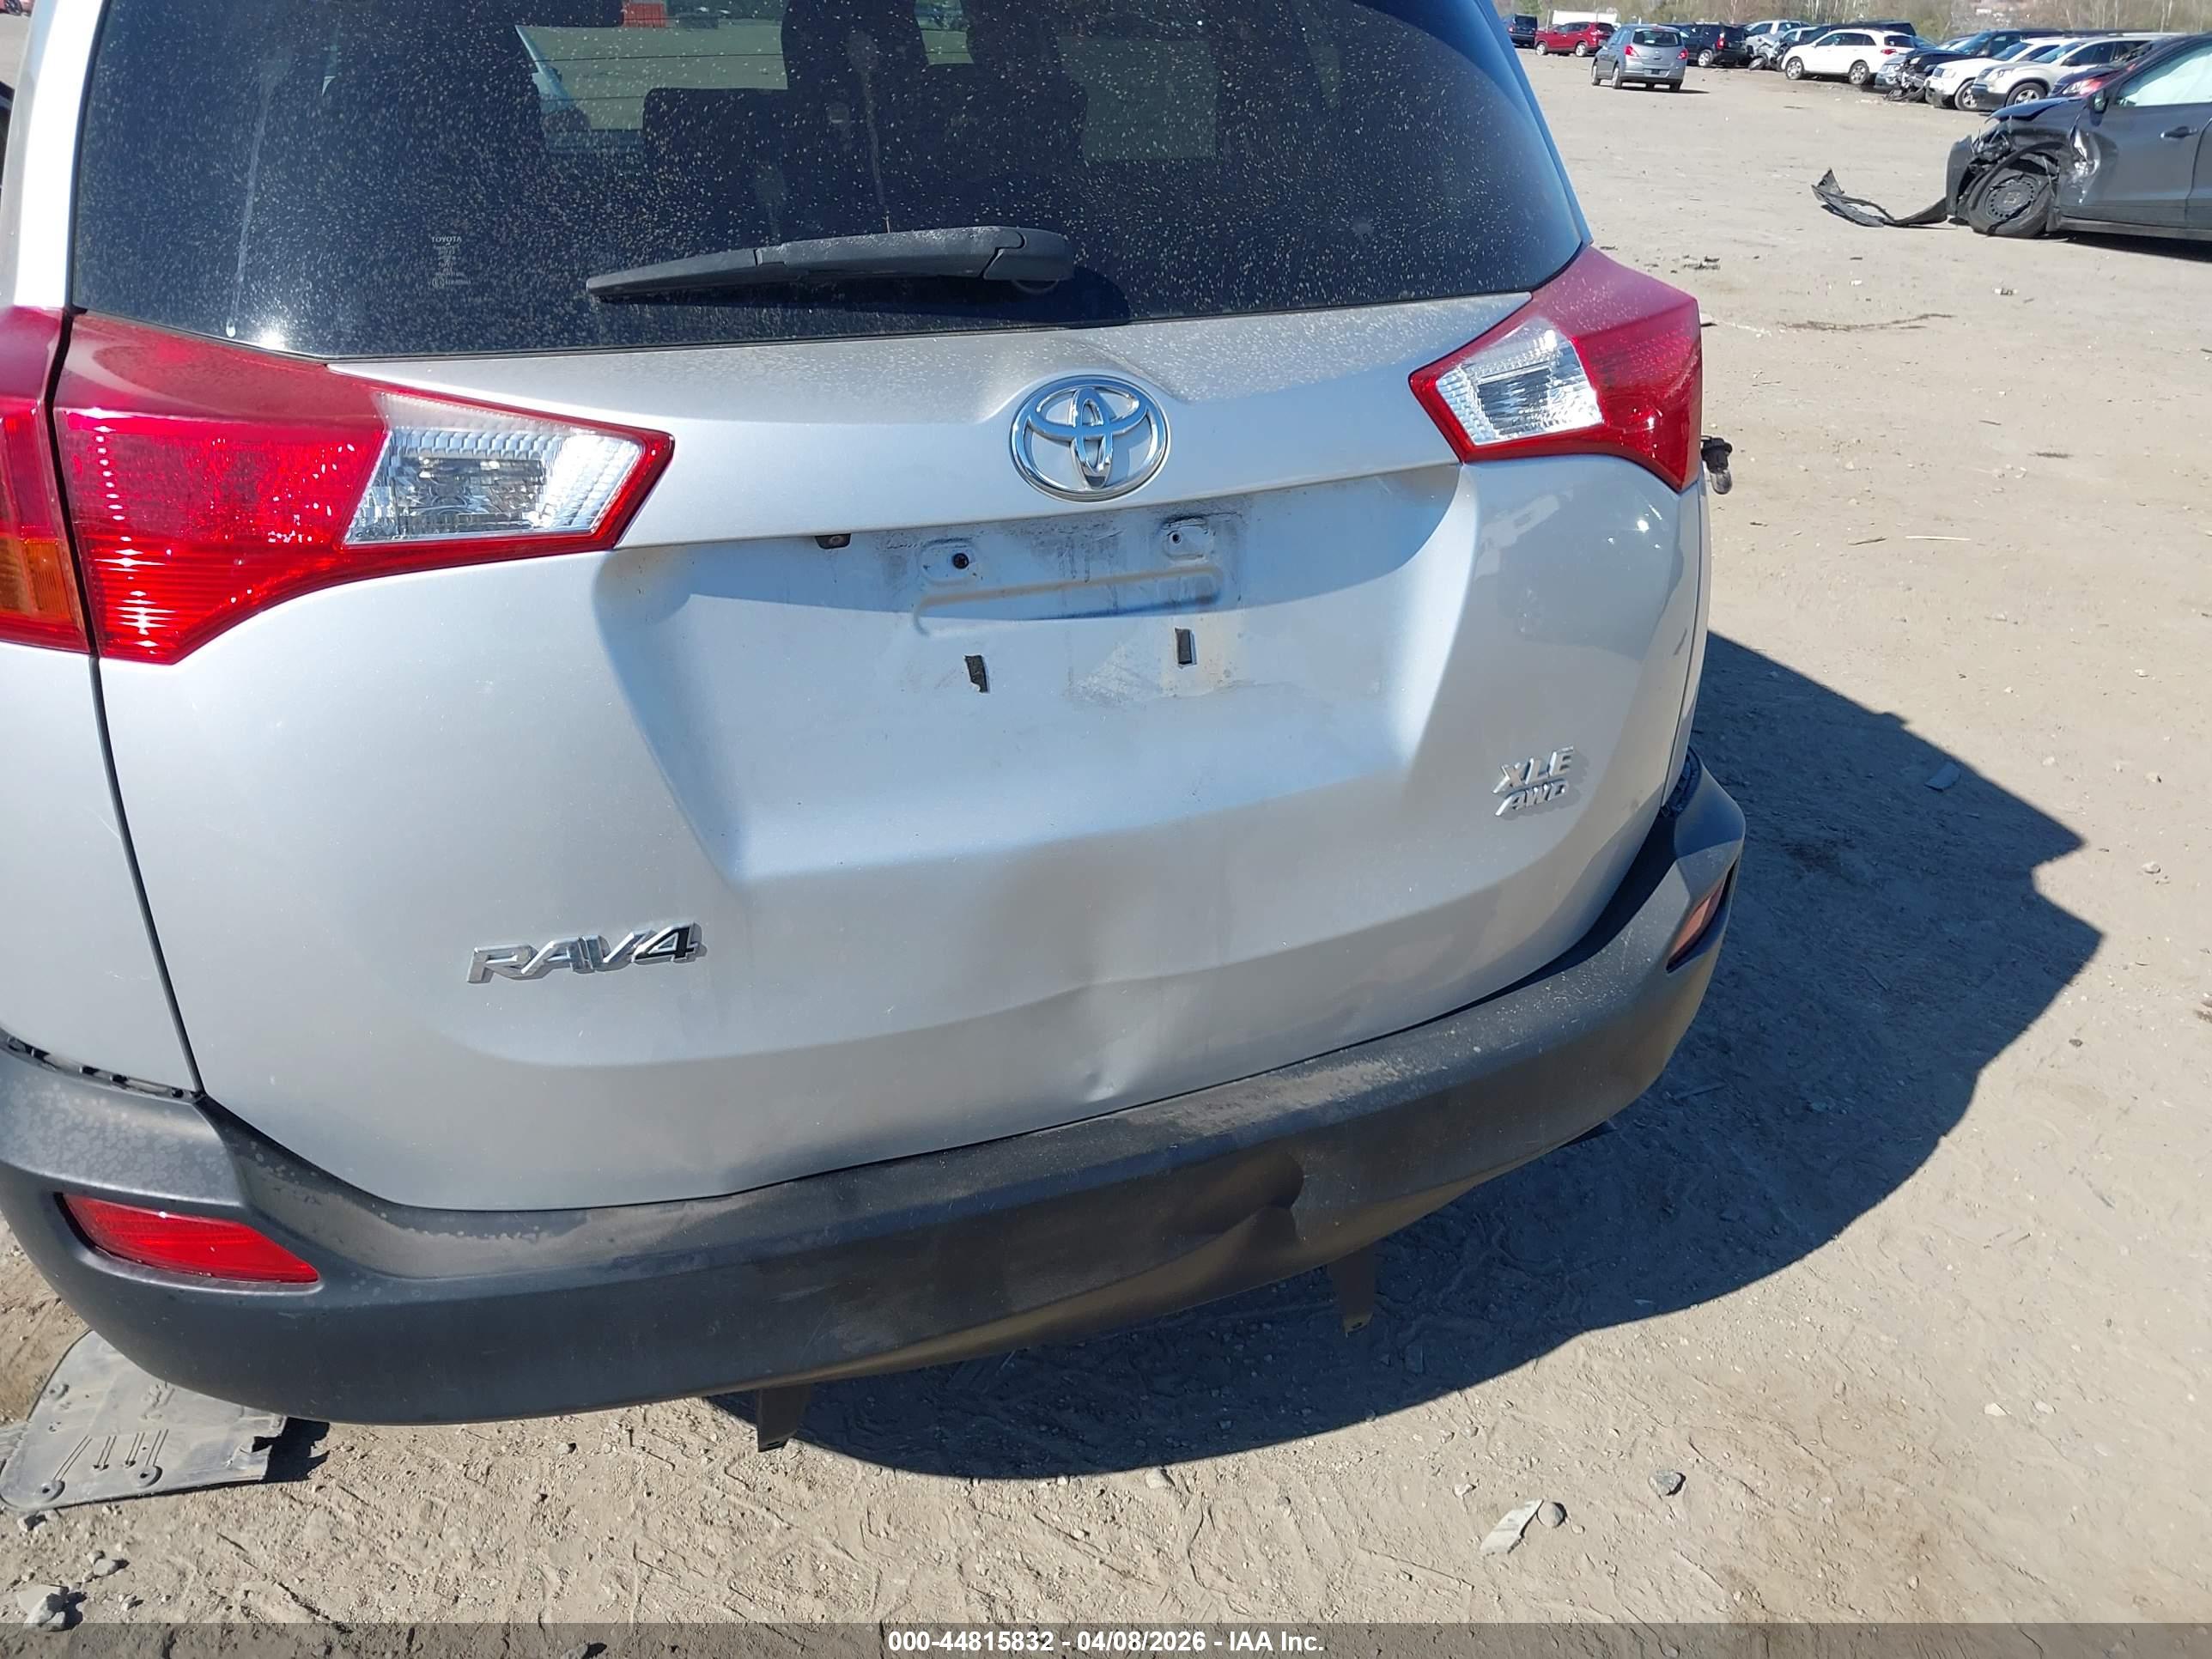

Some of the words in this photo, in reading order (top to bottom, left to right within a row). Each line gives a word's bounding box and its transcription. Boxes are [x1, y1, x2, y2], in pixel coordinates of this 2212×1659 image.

[1493, 745, 1574, 793] XLE
[1495, 778, 1570, 816] AWD
[466, 922, 704, 983] RAV4
